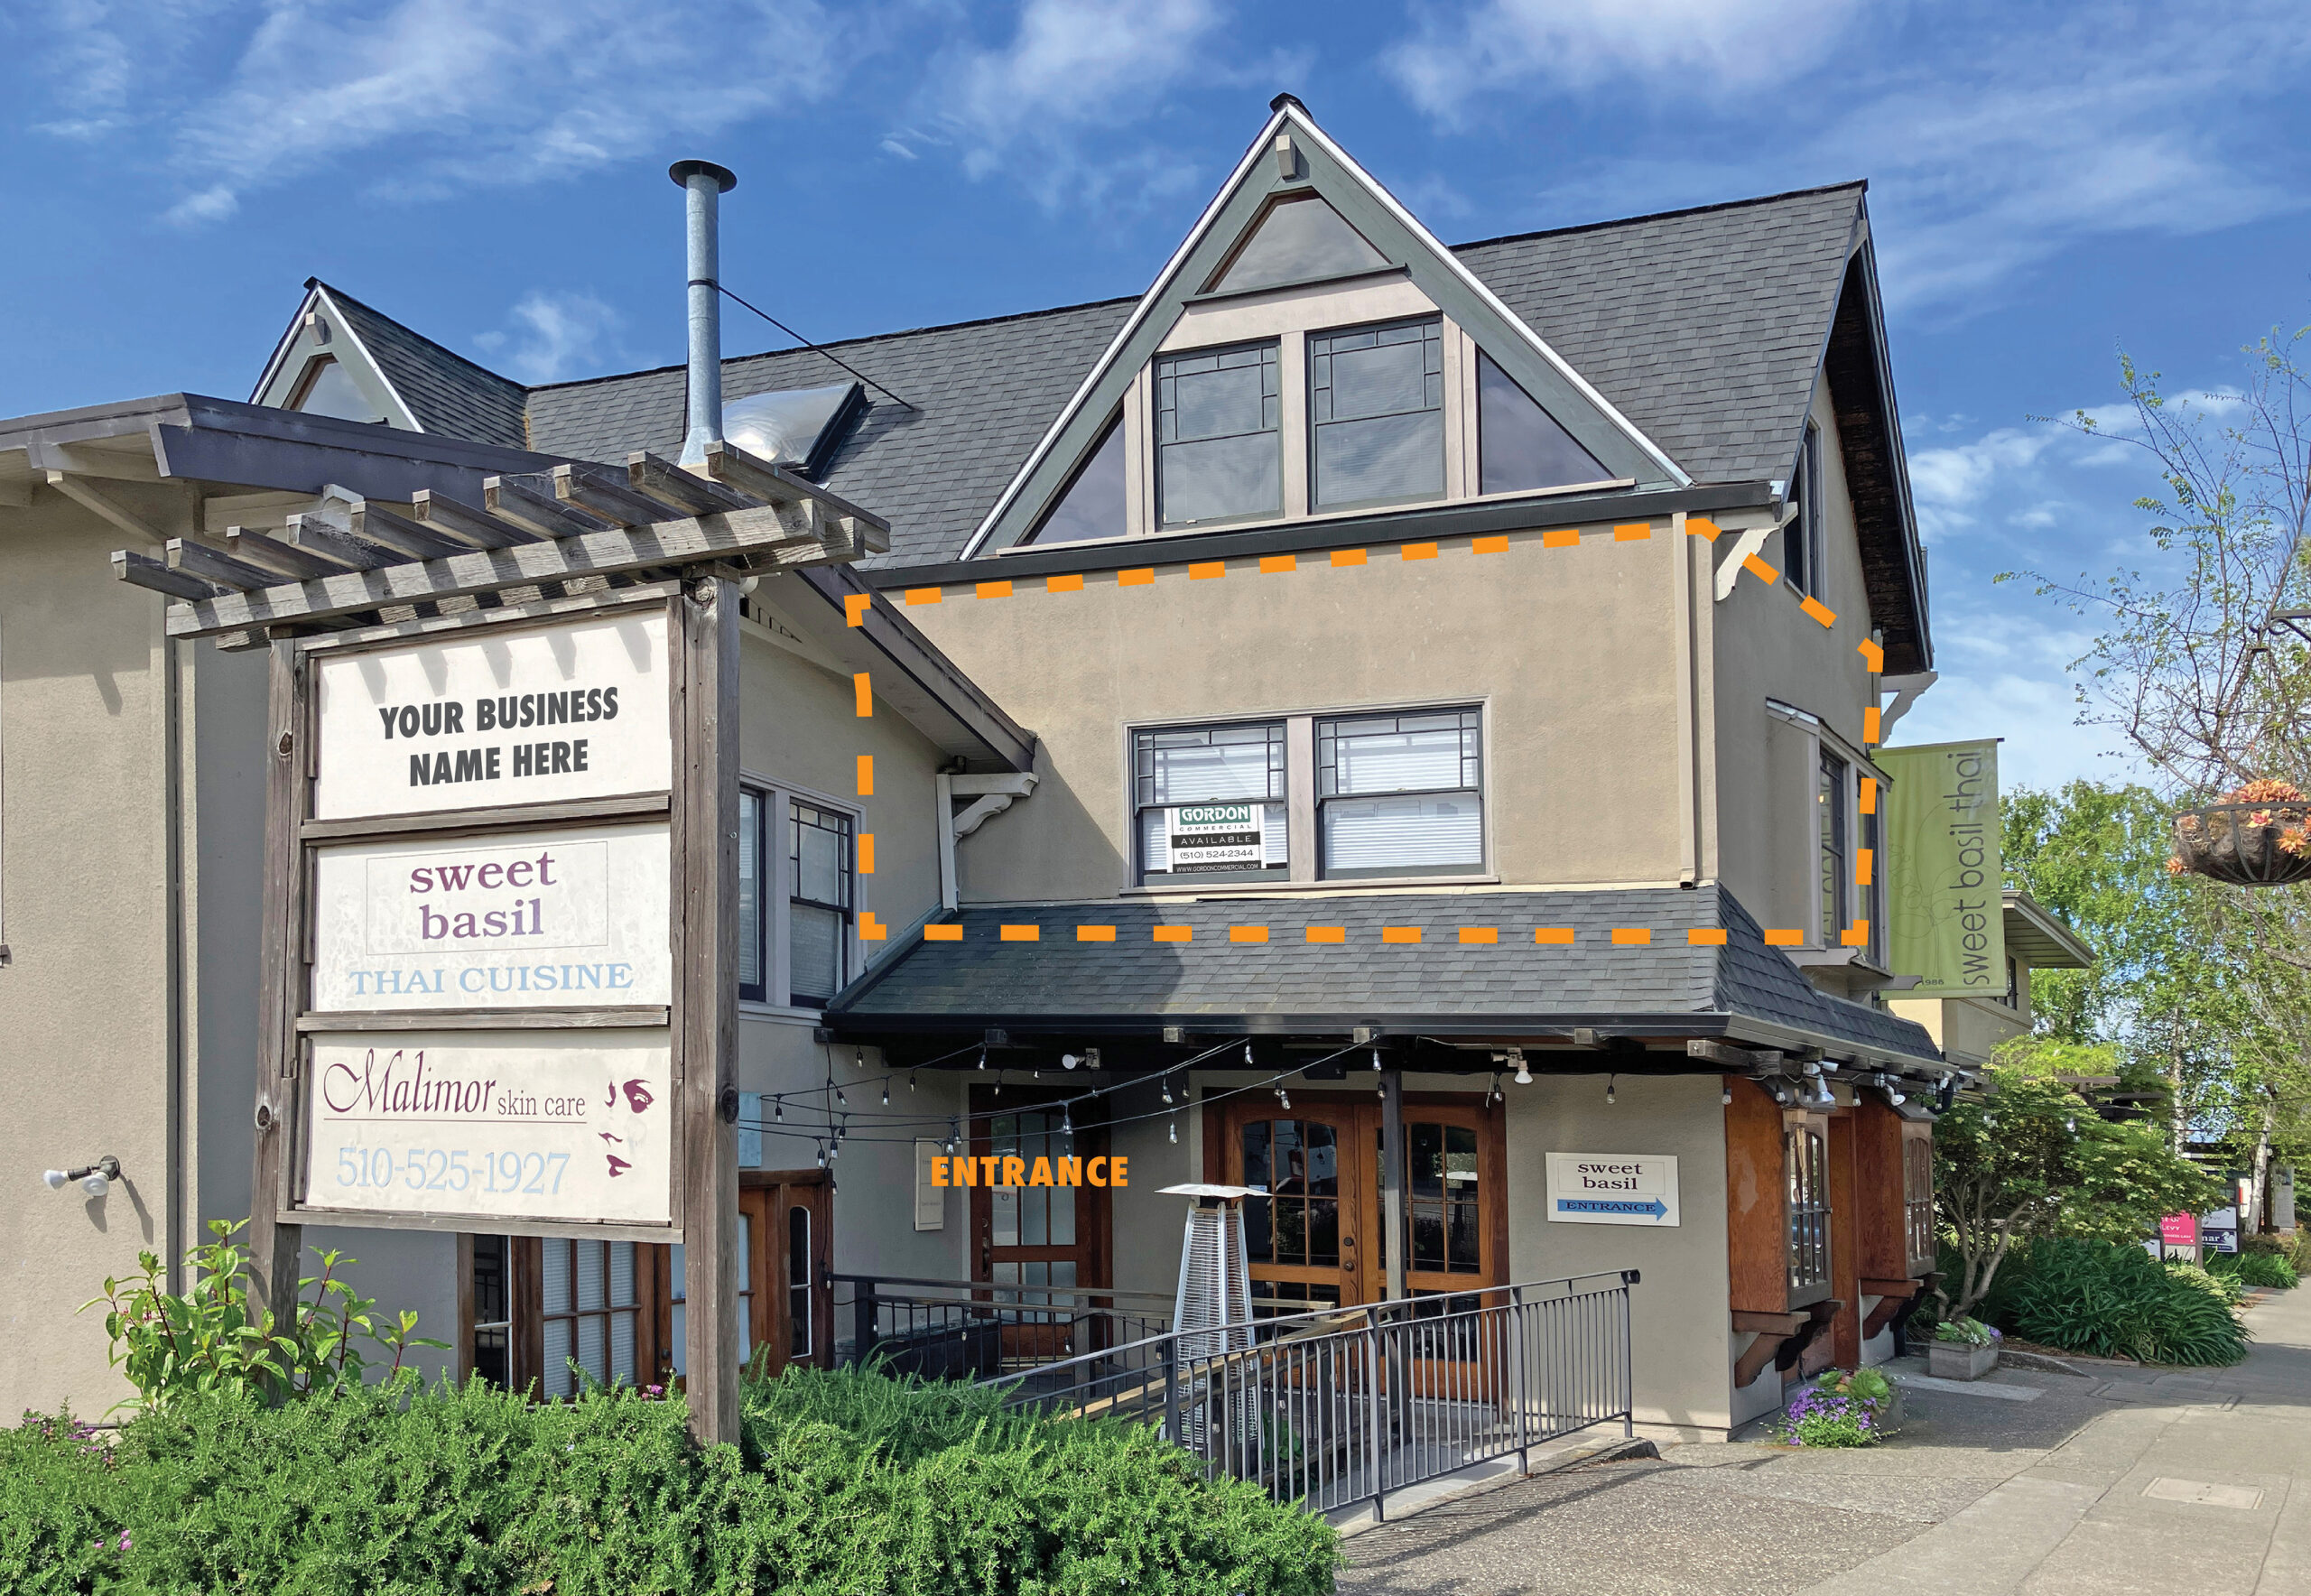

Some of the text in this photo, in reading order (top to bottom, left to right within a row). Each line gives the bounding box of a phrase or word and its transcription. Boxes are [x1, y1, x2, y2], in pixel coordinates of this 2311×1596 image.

[378, 686, 618, 739] YOUR BUSINESS
[410, 738, 589, 786] NAME HERE
[1181, 806, 1248, 821] GORDON
[1180, 849, 1253, 859] (510) 524-2344
[1181, 835, 1252, 845] AVAILABLE
[410, 851, 557, 894] sweet
[1176, 863, 1258, 873] WWW.GORDONCOMMERCIAL.COM
[1943, 752, 1990, 985] sweet basil thai
[419, 898, 544, 940] basil
[348, 962, 634, 995] THAI CUISINE
[323, 1048, 586, 1117] Malimor skin care
[337, 1147, 571, 1194] 510-525-1927
[1578, 1163, 1643, 1174] sweet
[1582, 1176, 1638, 1190] basil
[1566, 1202, 1656, 1212] ENTRANCE
